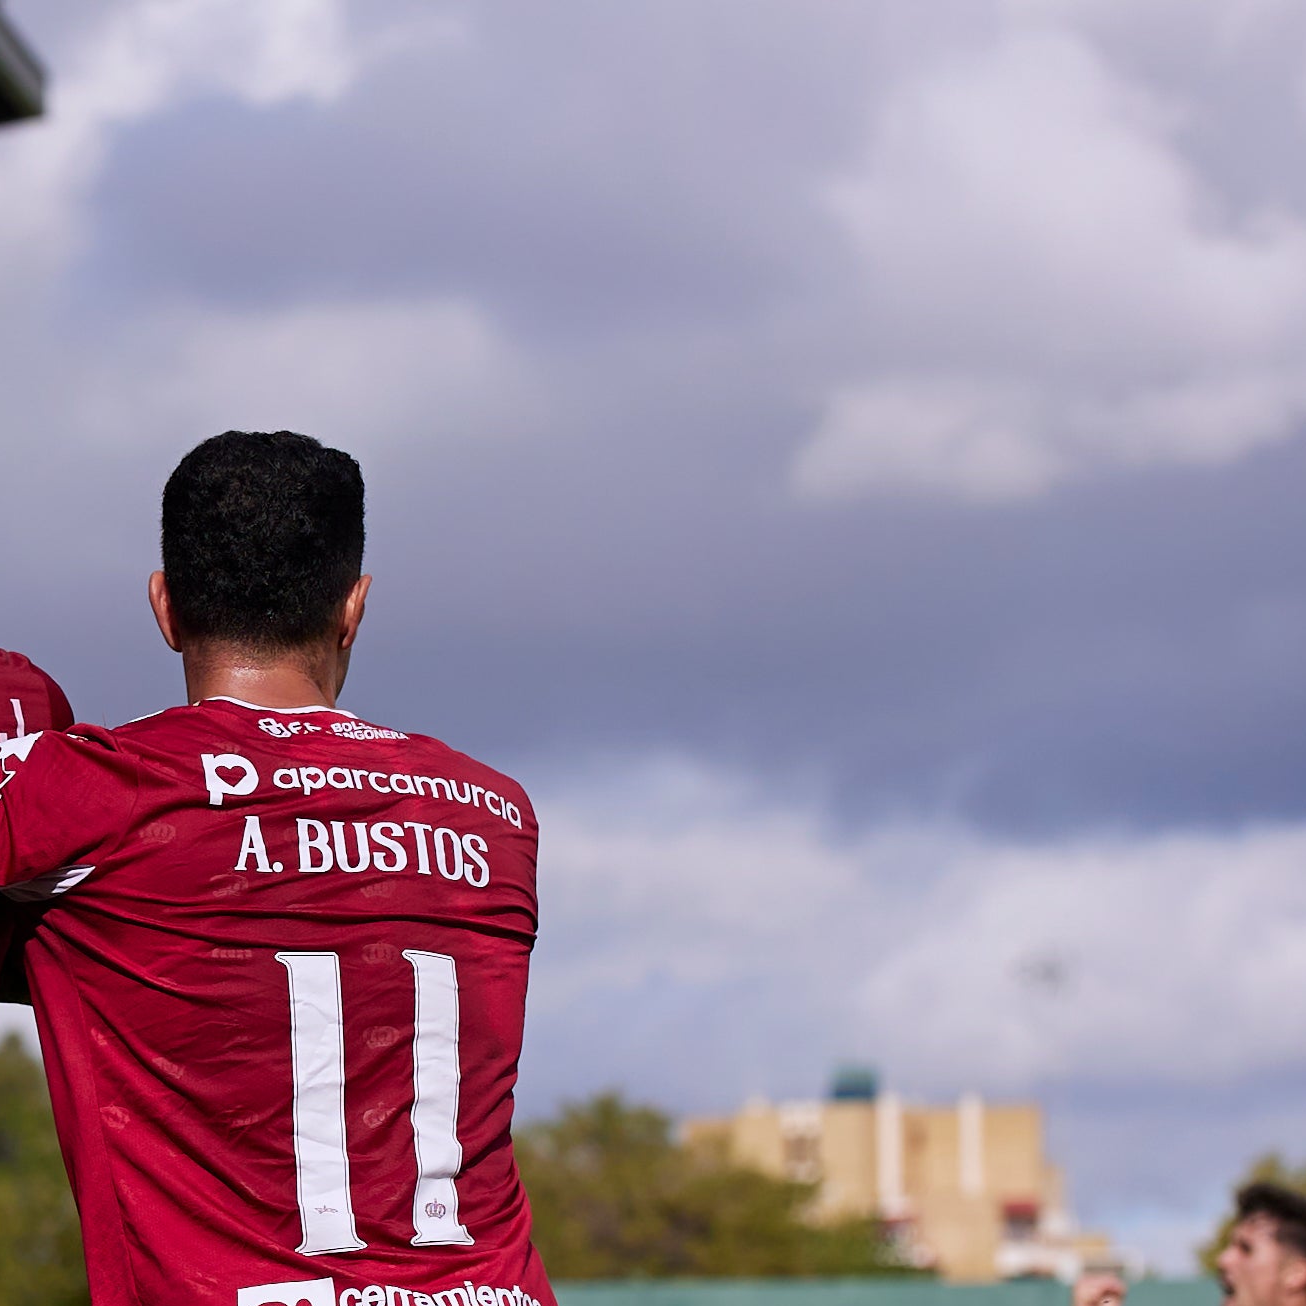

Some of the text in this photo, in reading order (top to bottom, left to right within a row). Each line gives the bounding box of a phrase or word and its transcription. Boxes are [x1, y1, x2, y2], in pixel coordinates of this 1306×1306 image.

[272, 765, 523, 830] aparcamurcia
[234, 815, 490, 888] A. BUSTOS
[274, 949, 476, 1257] 11
